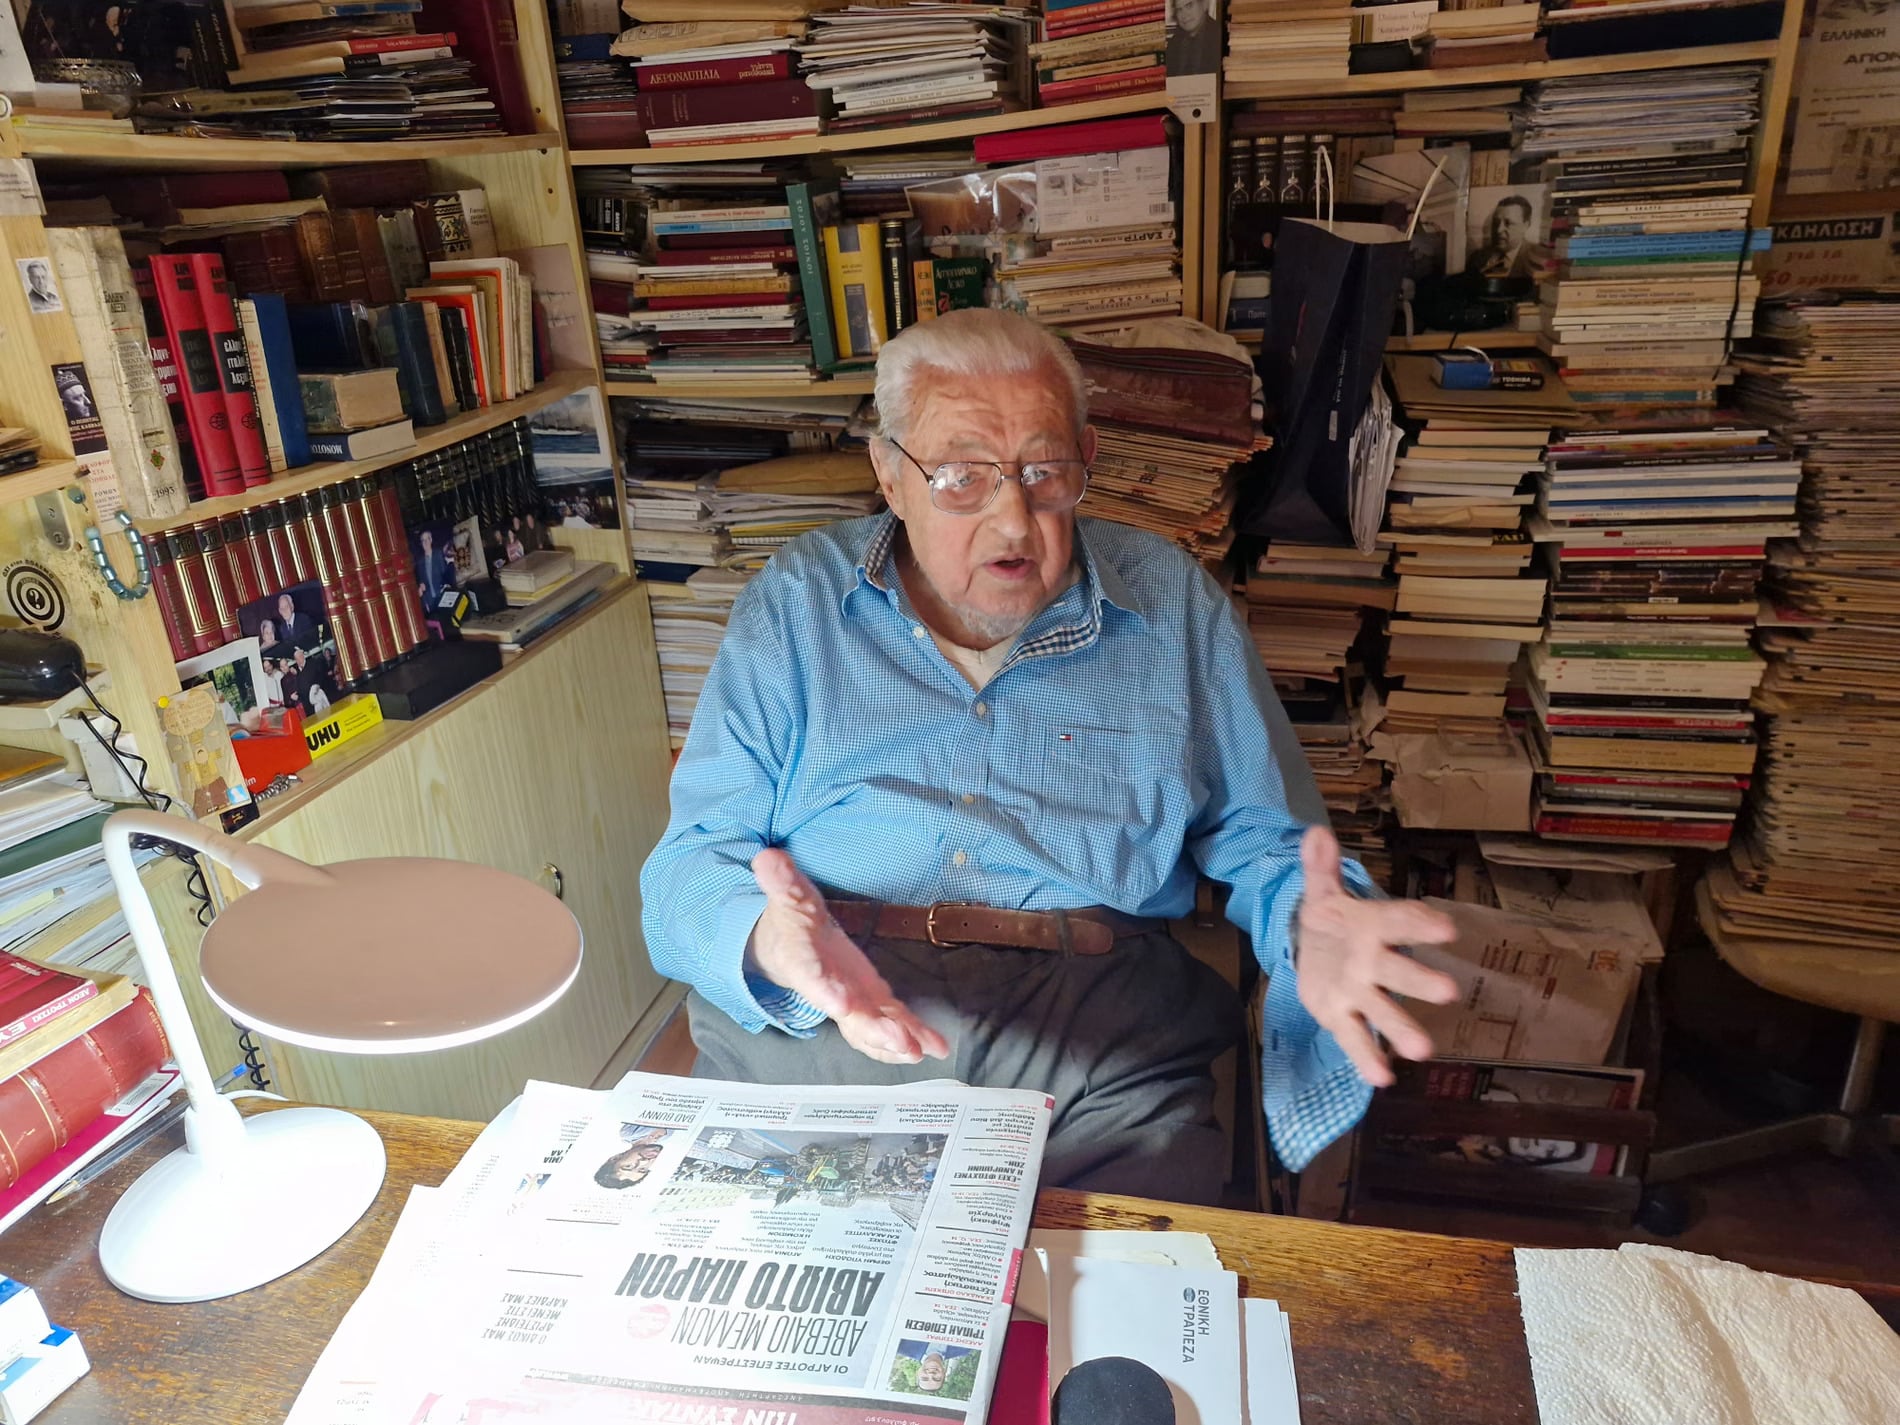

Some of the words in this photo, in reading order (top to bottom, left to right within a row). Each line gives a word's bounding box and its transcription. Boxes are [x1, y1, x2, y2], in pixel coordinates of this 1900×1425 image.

[1775, 222, 1875, 240] ΚΔΗΛΩΣΗ
[803, 238, 813, 275] ΙΟΝΙΟΣ
[305, 721, 341, 751] UHU
[638, 1110, 674, 1122] BUNNY
[674, 1113, 696, 1123] BAD
[968, 1209, 1012, 1220] ολιγαρχία
[970, 1215, 1011, 1228] Ψηφιακή
[843, 1230, 886, 1238] ΑΚΑΛΥΠΤΕΣ
[825, 1254, 862, 1262] ΥΠΟΔΟΧΗ
[615, 1252, 748, 1309] ΠΑΡΟΝ
[923, 1270, 997, 1287] κουκουλώματος
[743, 1261, 885, 1317] ΑΒΙΩΤΟ
[944, 1280, 995, 1295] Εξεταστική
[500, 1293, 525, 1304] ΜΑΣ
[524, 1295, 568, 1308] ΚΑΡΔΙΕΣ
[504, 1305, 528, 1317] ΣΤΙΣ
[526, 1307, 562, 1320] ΜΕΝΕΙ
[1197, 1289, 1210, 1336] ΕΘΝΙΚΗ
[494, 1317, 554, 1332] ΑΡΙΣΤΕΙΔΗΣ
[671, 1306, 769, 1353] ΜΕΛΛΟΝ
[905, 1319, 947, 1334] ΕΠΙΘΕΣΗ
[948, 1324, 985, 1340] ΤΡΙΠΛΗ
[480, 1328, 506, 1341] ΜΑΣ
[766, 1312, 868, 1357] ΑΒΕΒΑΙΟ
[1182, 1304, 1195, 1363] ΤΡΑΠΕΖΑ
[693, 1355, 774, 1370] ΕΠΕΣΤΡΕΨΑΝ
[775, 1360, 832, 1372] ΑΓΡΟΤΕΣ
[834, 1364, 849, 1375] ΟΙ
